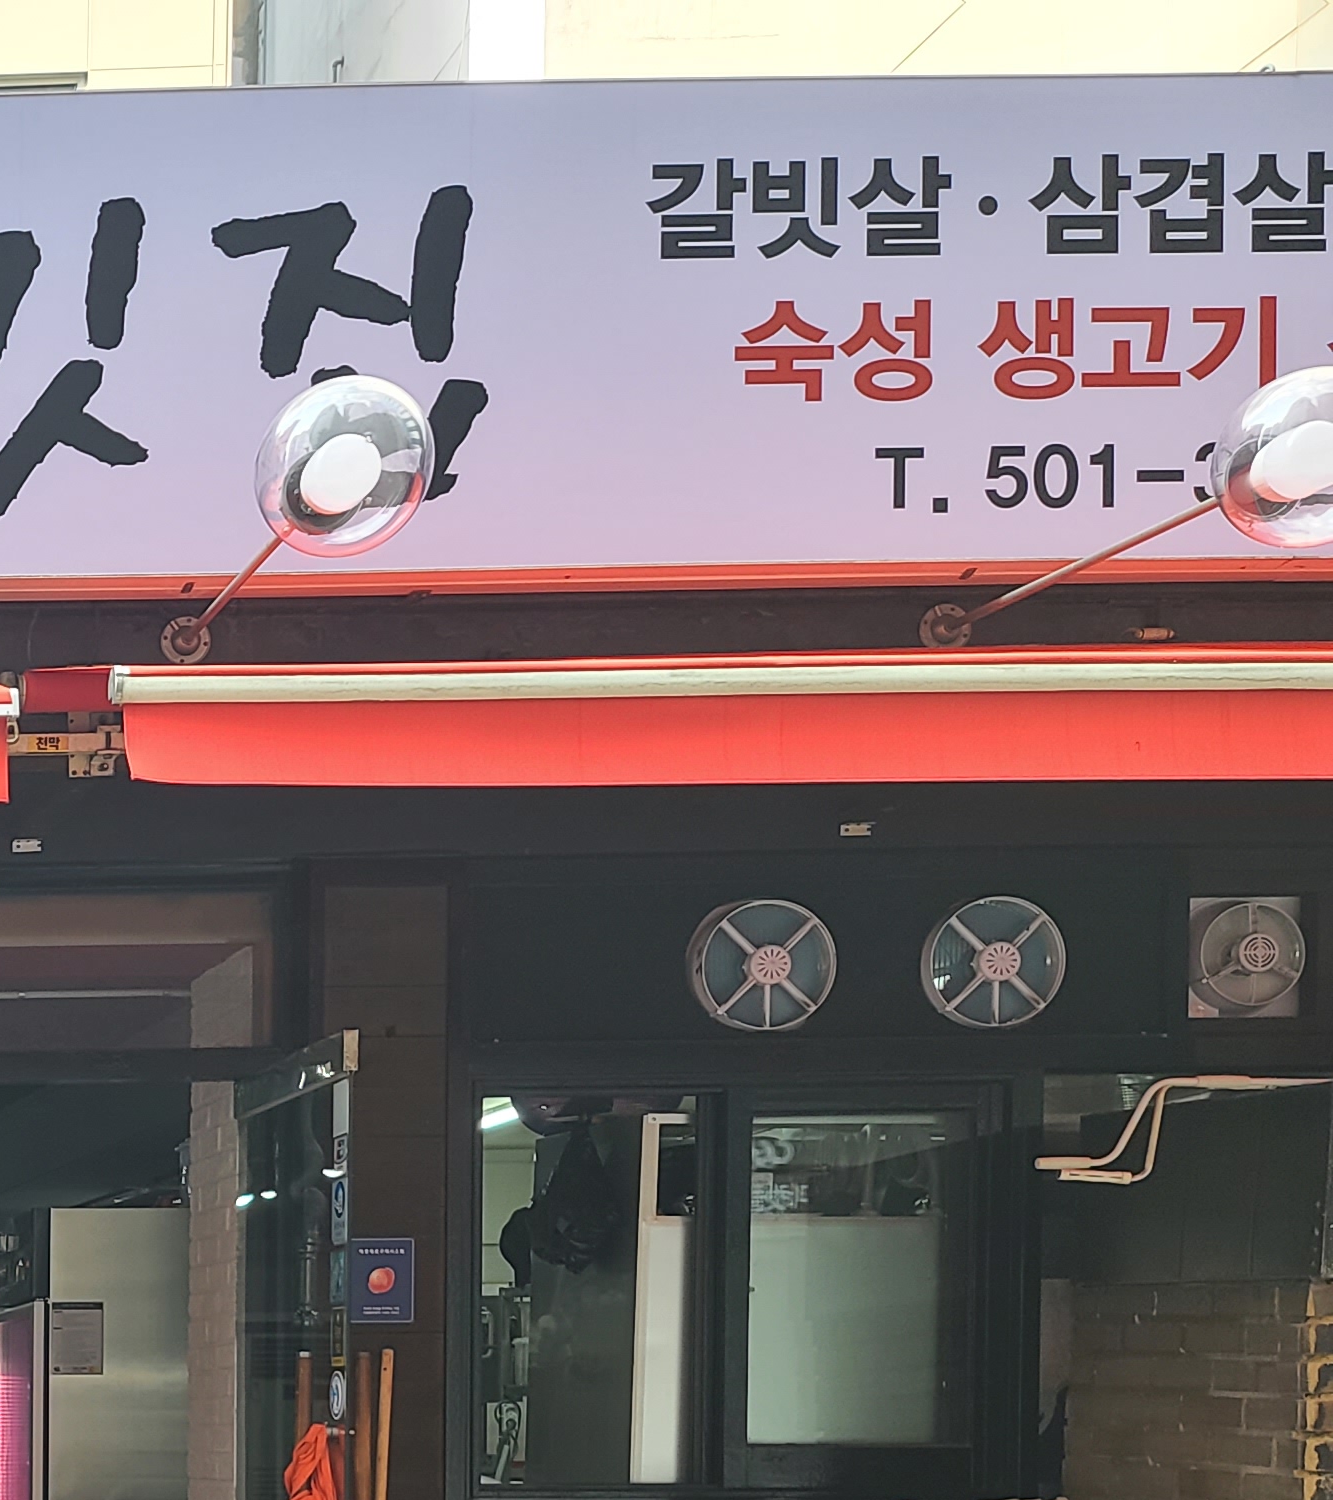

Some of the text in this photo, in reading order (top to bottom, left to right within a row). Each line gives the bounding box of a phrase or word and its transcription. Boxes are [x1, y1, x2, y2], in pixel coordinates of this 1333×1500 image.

[645, 150, 1333, 260] 갈빗살 삼겹살
[734, 294, 1278, 402] 숙성 생고기
[873, 446, 950, 513] T.
[36, 736, 60, 750] 천막
